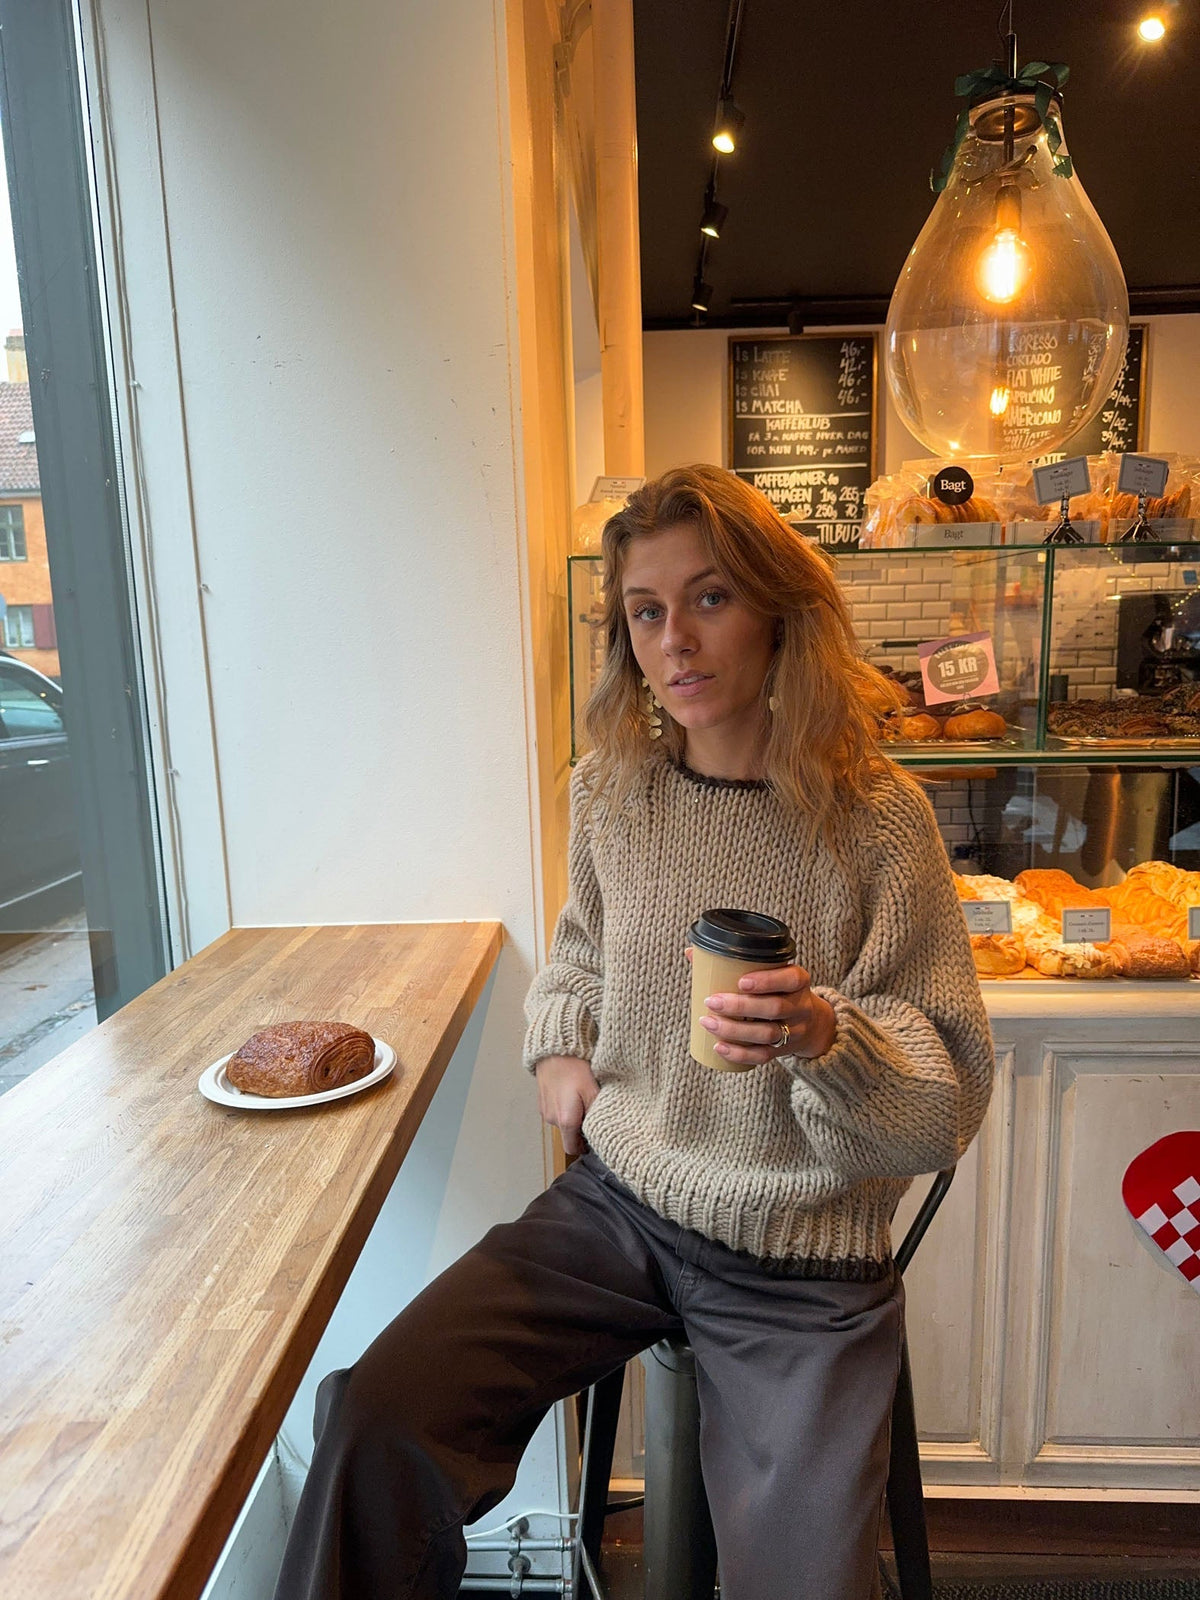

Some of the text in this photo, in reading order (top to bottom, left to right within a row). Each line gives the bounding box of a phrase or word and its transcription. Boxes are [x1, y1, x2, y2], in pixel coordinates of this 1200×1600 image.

[1006, 352, 1052, 367] CORTADO
[1030, 365, 1062, 386] WHITE
[1009, 386, 1056, 405] APPUCINO
[751, 400, 804, 414] MATCHA
[766, 417, 831, 431] KAFFEKLUB
[782, 431, 813, 441] KAFFE
[815, 431, 844, 440] HVER
[847, 431, 868, 440] DAG
[769, 445, 791, 454] KUN
[754, 471, 827, 489] KAFFEBØNNER
[940, 479, 967, 493] Bagt
[815, 503, 838, 520] 250g
[816, 524, 861, 544] TILBUD
[944, 529, 964, 540] Bagt
[937, 656, 978, 678] 15 KR
